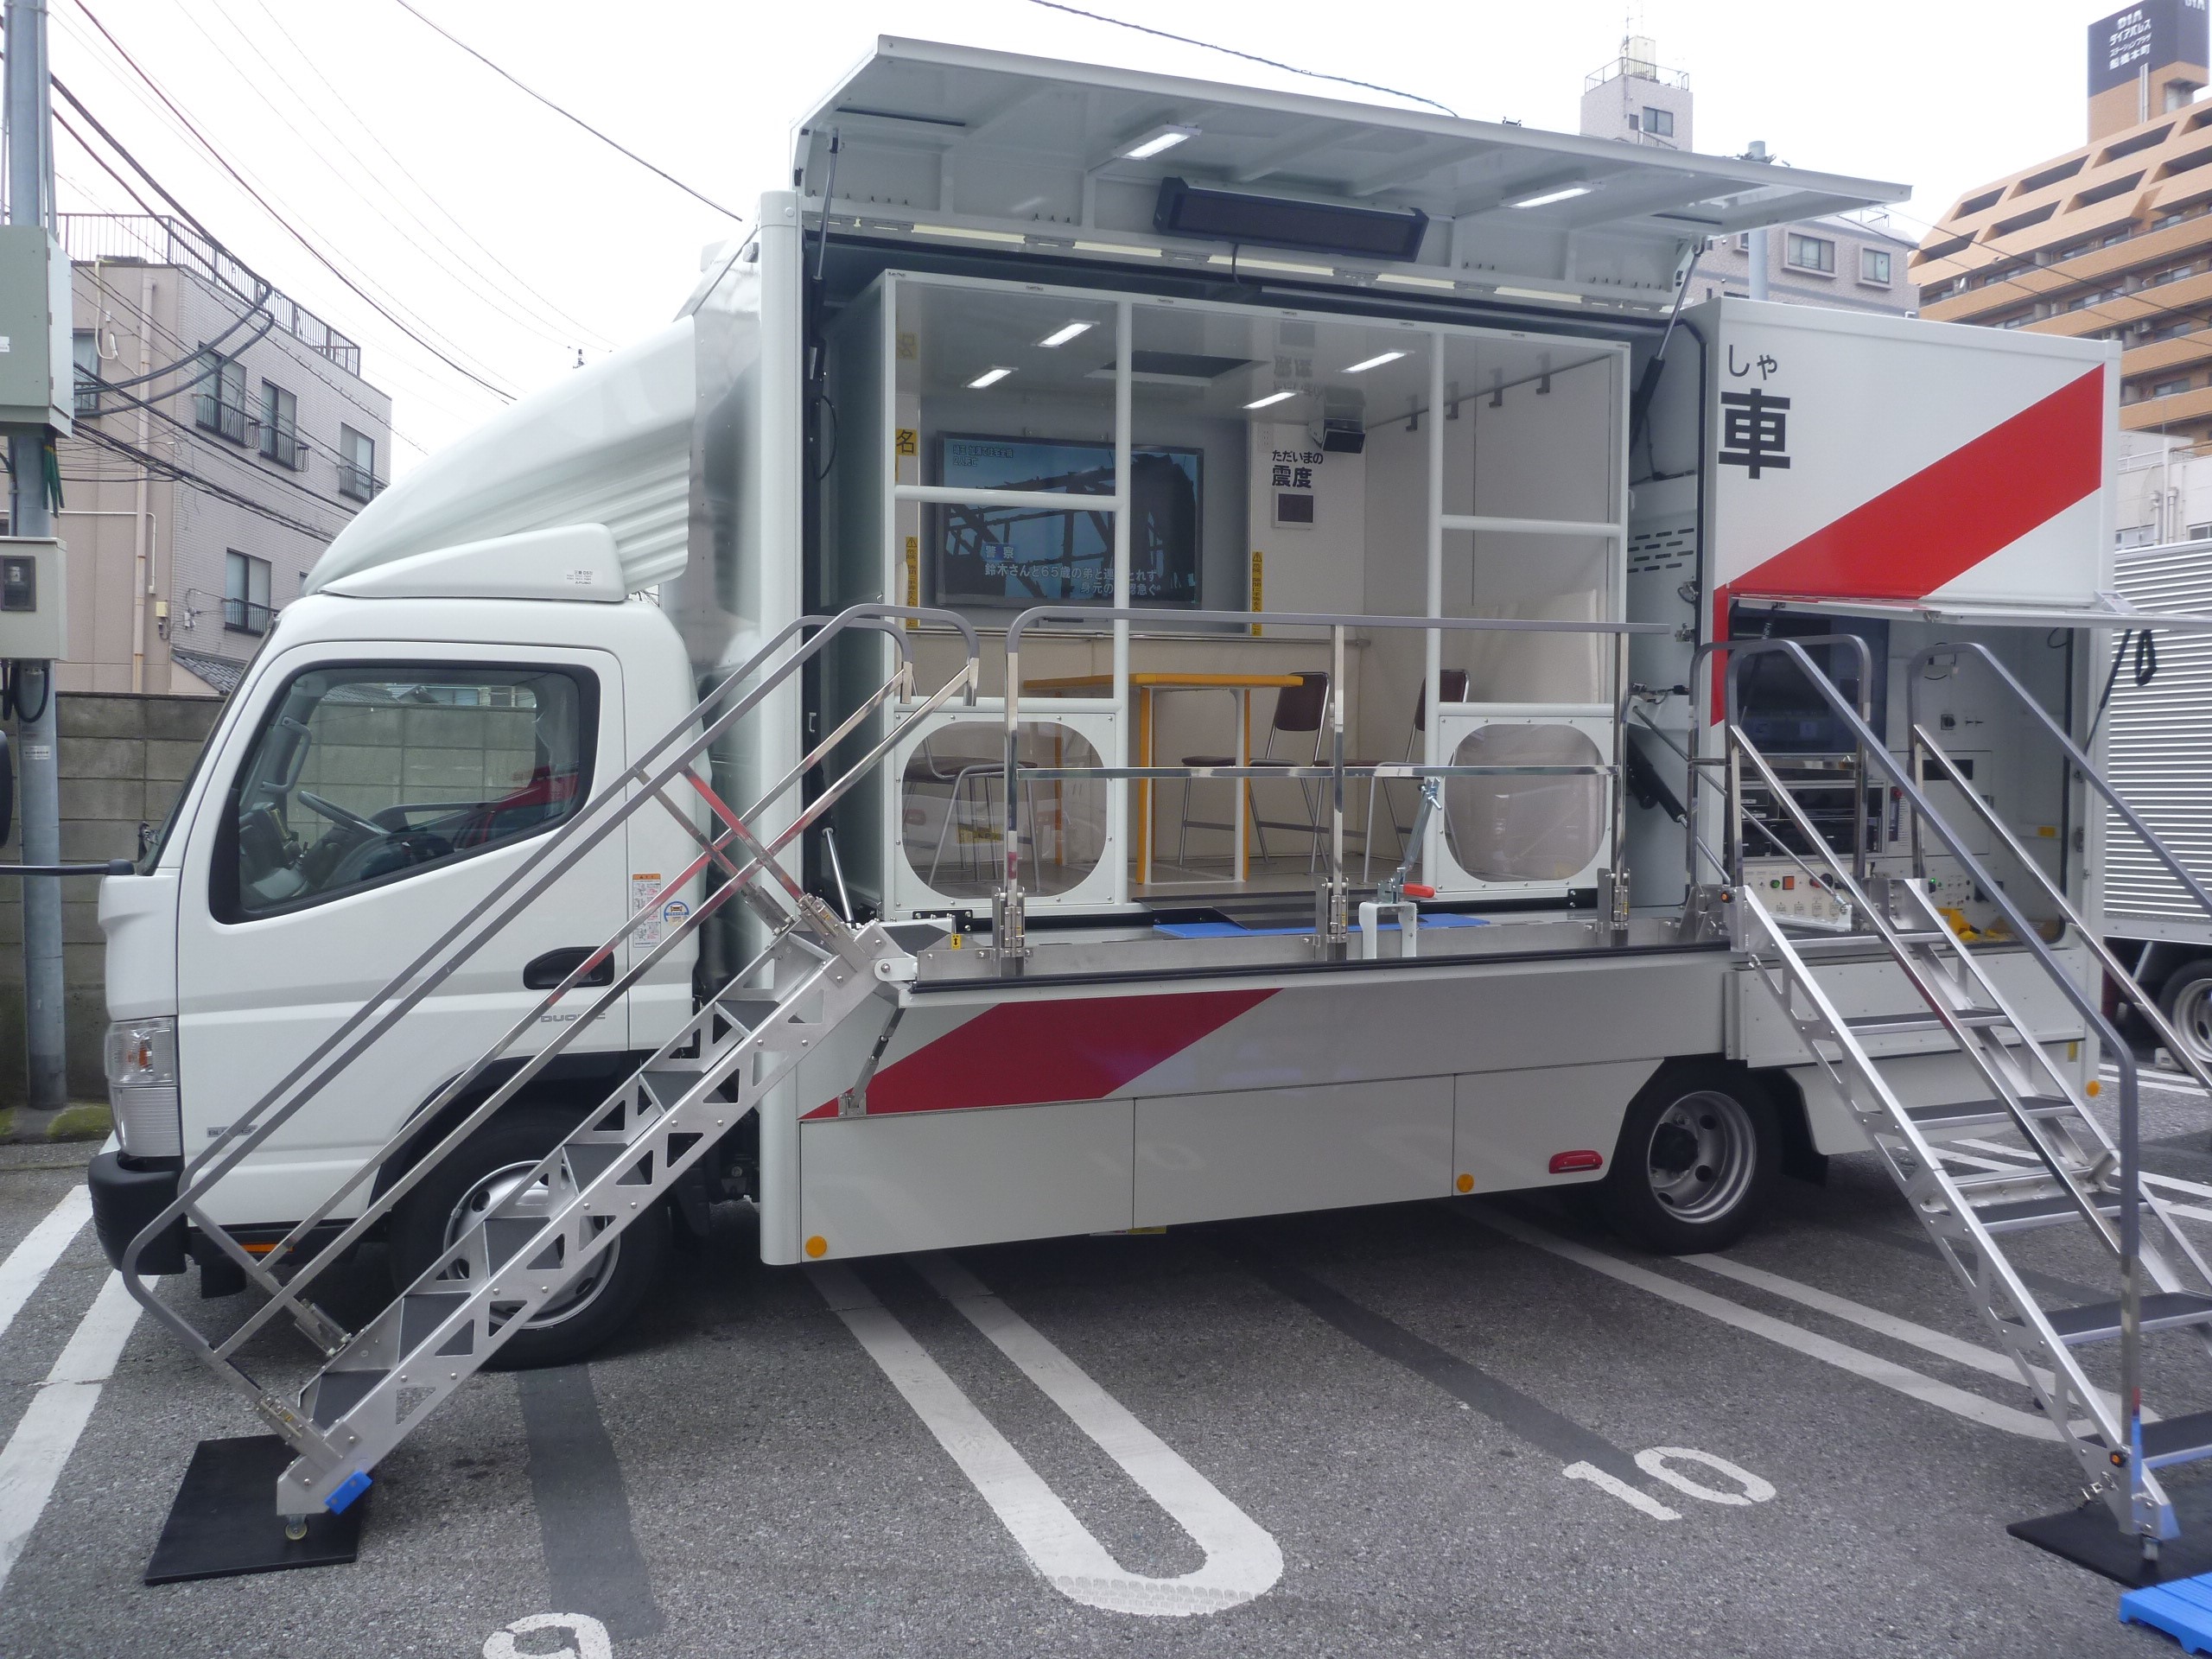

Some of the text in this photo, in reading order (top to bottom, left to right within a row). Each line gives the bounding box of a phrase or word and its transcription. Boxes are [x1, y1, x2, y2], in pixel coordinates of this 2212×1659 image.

[2117, 9, 2143, 29] DIA
[2109, 18, 2152, 46] ダイアパレス
[1729, 344, 1777, 380] しゃ
[896, 429, 914, 454] 名
[1718, 387, 1791, 480] 車
[1272, 449, 1324, 465] ただいまの
[1272, 465, 1313, 489] 震度
[984, 563, 1157, 582] 鈴木さんと65歳の弟と連とれず
[1080, 582, 1156, 596] 身元の認急ぐ
[1562, 1446, 1777, 1521] 10
